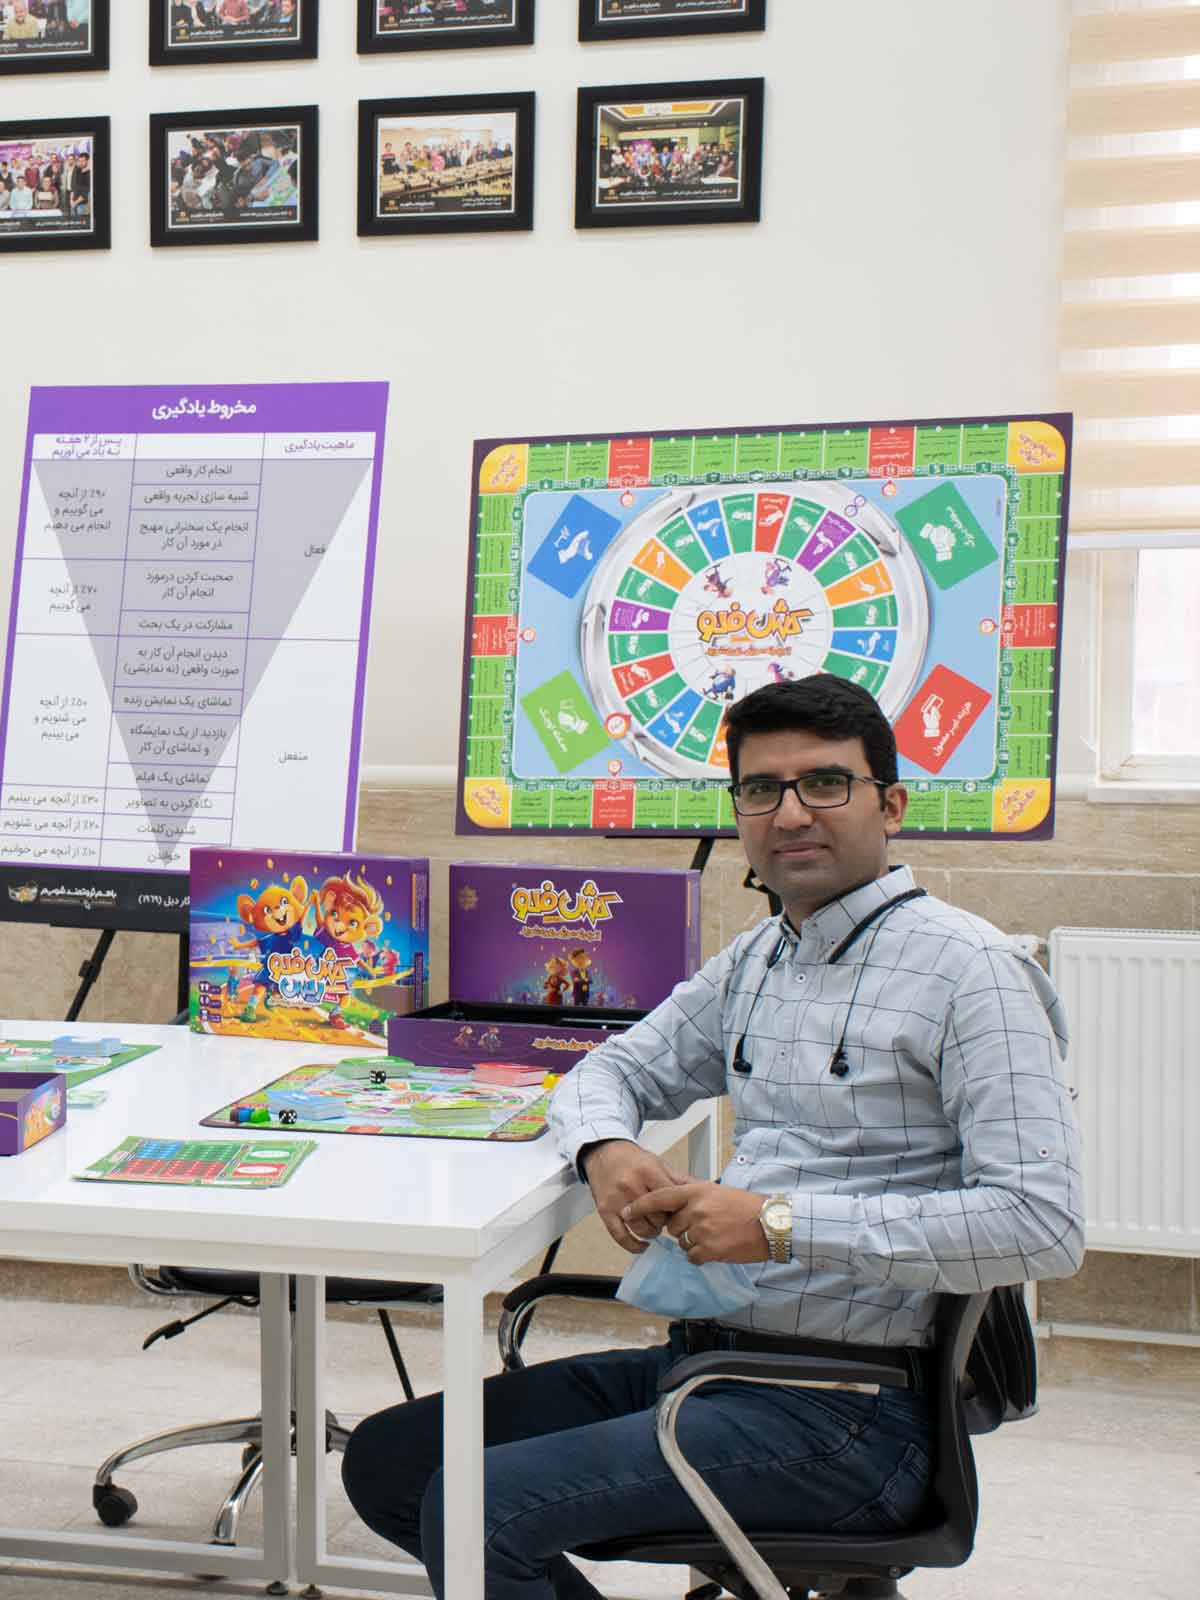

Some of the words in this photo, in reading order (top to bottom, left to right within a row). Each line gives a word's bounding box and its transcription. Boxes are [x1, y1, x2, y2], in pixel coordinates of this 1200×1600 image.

[152, 397, 205, 420] یادگیری
[207, 400, 257, 419] مخروط
[284, 439, 322, 453] یادگیری
[322, 439, 355, 451] ماهیت
[166, 466, 192, 478] واقعی
[195, 464, 208, 477] کار
[208, 466, 233, 477] انجام
[143, 491, 171, 504] واقعی
[172, 490, 199, 504] تجربه
[201, 491, 226, 504] سازی
[226, 491, 249, 502] شبیه
[206, 521, 223, 532] یک
[224, 522, 249, 535] انجام
[161, 537, 174, 550] کار
[174, 536, 188, 549] آن
[190, 539, 210, 550] مورد
[211, 538, 222, 549] در
[176, 570, 199, 583] کردن
[200, 571, 234, 582] صحبت
[161, 587, 175, 600] کار
[176, 585, 188, 599] آن
[189, 588, 215, 599] انجام
[164, 619, 181, 630] یک
[182, 622, 193, 633] در
[195, 619, 233, 632] مشارکت
[696, 601, 747, 643] فلو
[148, 647, 162, 661] کار
[163, 647, 176, 662] آن
[176, 648, 203, 661] انجام
[203, 650, 228, 662] دیدن
[182, 664, 209, 677] واقعی
[210, 665, 240, 677] صورت
[144, 695, 177, 708] نمایش
[178, 695, 196, 706] یک
[199, 695, 233, 710] تماشای
[129, 722, 171, 737] نمایشگاه
[172, 725, 191, 736] یک
[202, 726, 228, 742] بازدید
[138, 741, 153, 755] کار
[153, 740, 167, 754] آن
[167, 741, 202, 756] تماشای
[277, 750, 309, 764] منفعل
[135, 771, 156, 784] فیلم
[176, 772, 210, 786] تماشای
[511, 880, 560, 924] فلو
[267, 946, 306, 981] فلو
